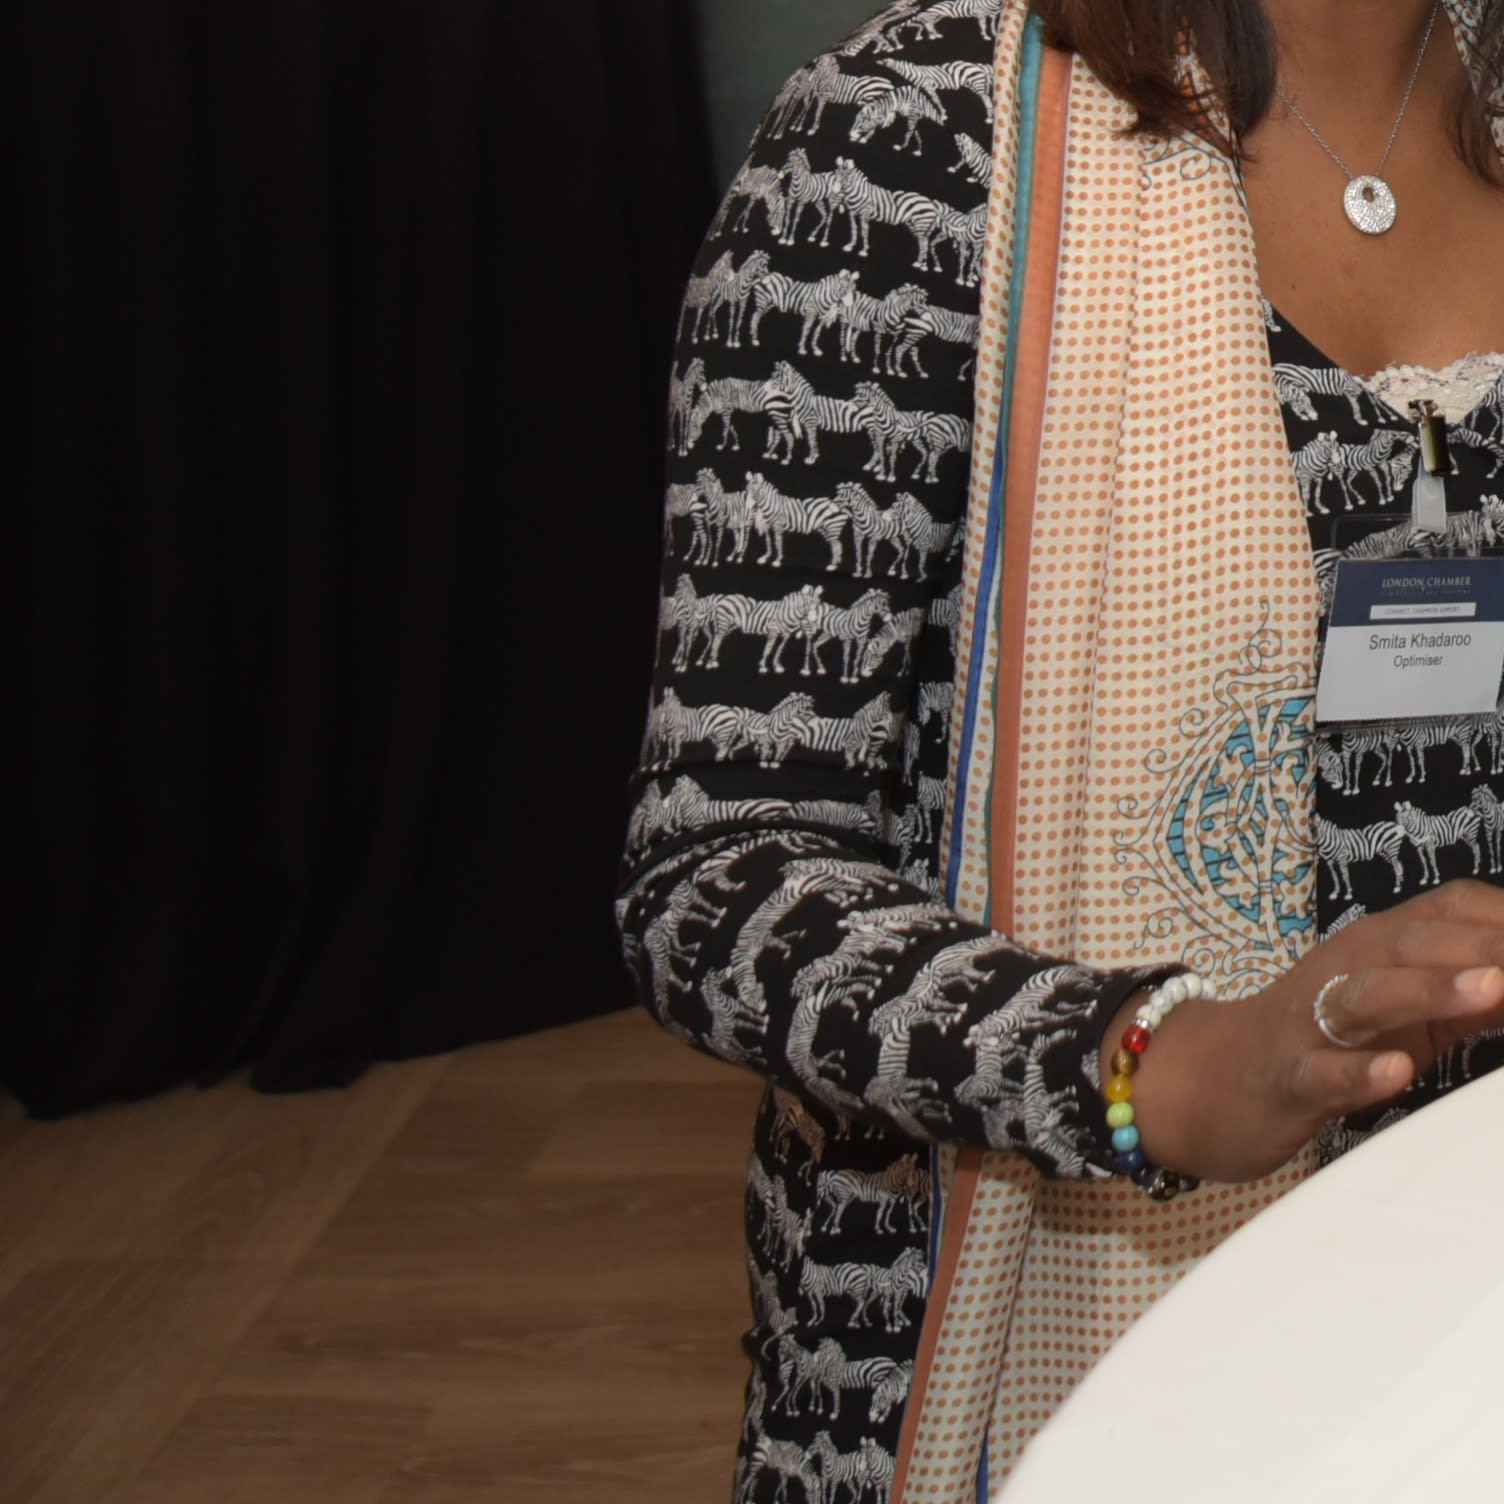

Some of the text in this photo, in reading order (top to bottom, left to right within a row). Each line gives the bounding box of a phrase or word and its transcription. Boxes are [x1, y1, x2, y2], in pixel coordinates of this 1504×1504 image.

[1382, 576, 1472, 589] LONDON CHAMBER
[1369, 632, 1472, 650] Smita Khadaroo
[1393, 655, 1444, 669] Optimiser
